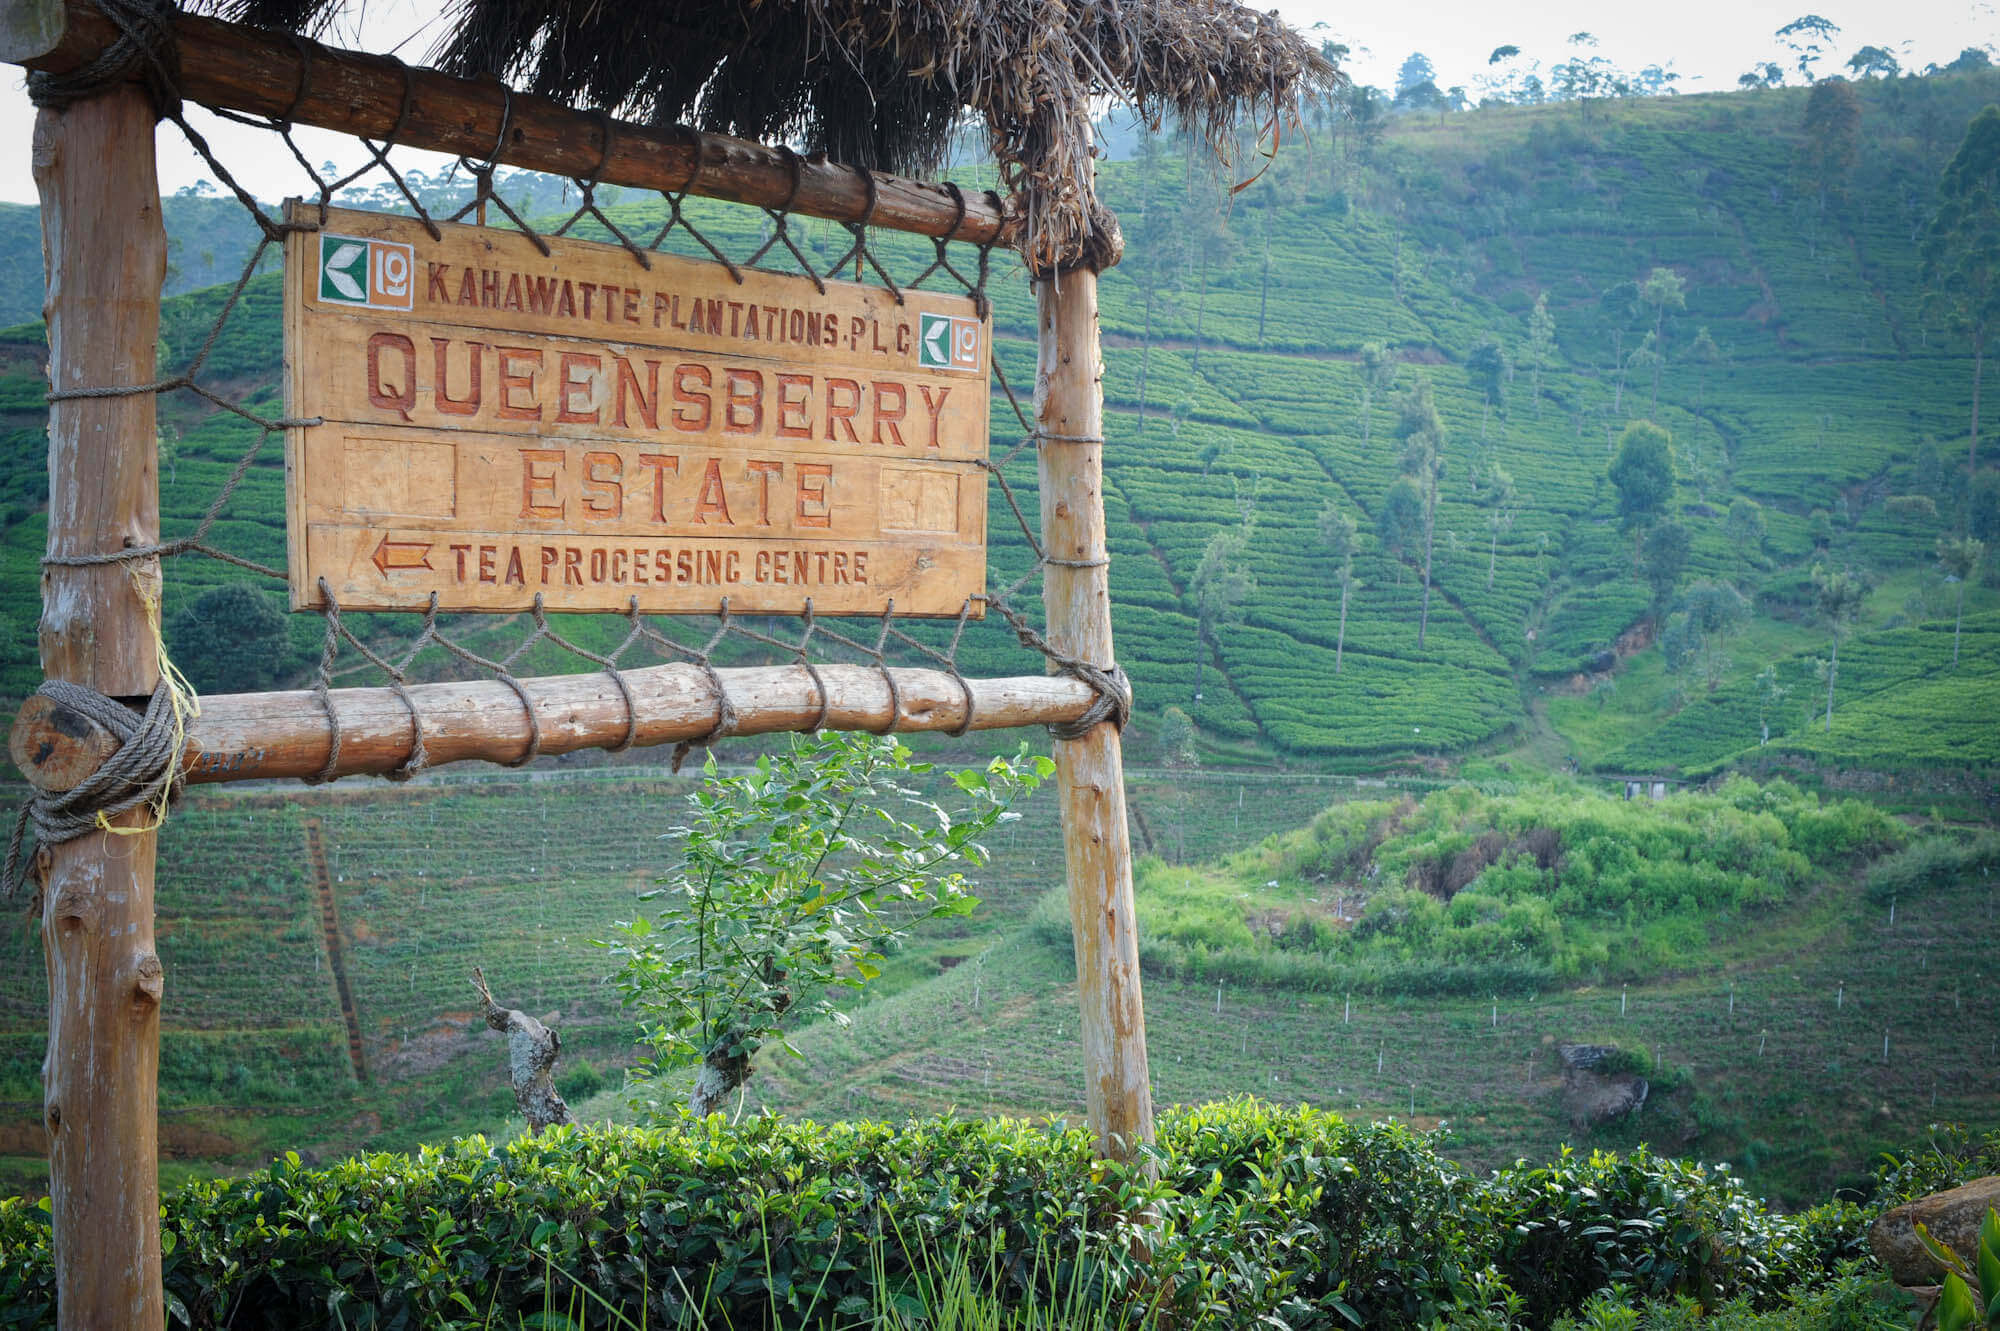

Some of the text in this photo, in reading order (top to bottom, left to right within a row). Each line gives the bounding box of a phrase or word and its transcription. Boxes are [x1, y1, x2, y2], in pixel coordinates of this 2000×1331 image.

[428, 261, 641, 325] KAHAWATTE
[367, 332, 953, 449] QUEENSBERRY
[518, 448, 833, 529] ESTATE
[449, 544, 526, 586] TEA
[754, 550, 869, 585] CENTRE
